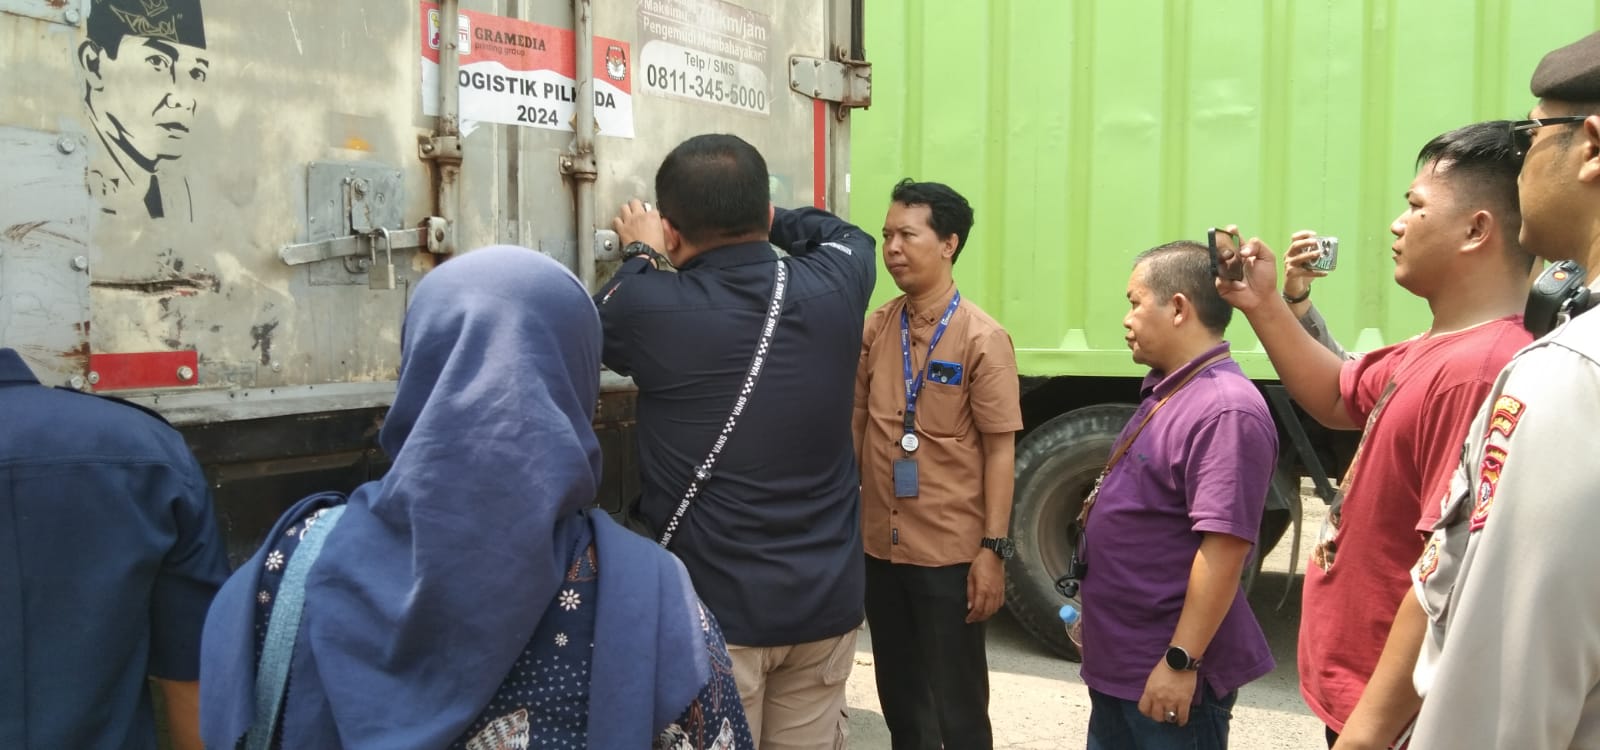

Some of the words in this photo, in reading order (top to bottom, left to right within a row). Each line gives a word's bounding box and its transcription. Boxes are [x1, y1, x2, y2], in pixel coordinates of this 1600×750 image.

[475, 27, 546, 51] GRAMEDIA
[643, 15, 696, 44] Pengemudi
[684, 51, 706, 72] Telp
[707, 57, 712, 71] /
[713, 59, 735, 76] SMS
[459, 69, 538, 98] OGISTIK
[543, 82, 616, 109] PILDA
[647, 64, 765, 111] 0811-345-5000
[517, 105, 559, 126] 2024
[660, 532, 673, 548] ANS
[675, 498, 690, 517] VANS
[711, 434, 728, 454] VANS
[731, 395, 747, 416] VANS
[749, 356, 763, 377] VANS
[764, 317, 776, 337] VANS
[774, 282, 785, 300] VANS
